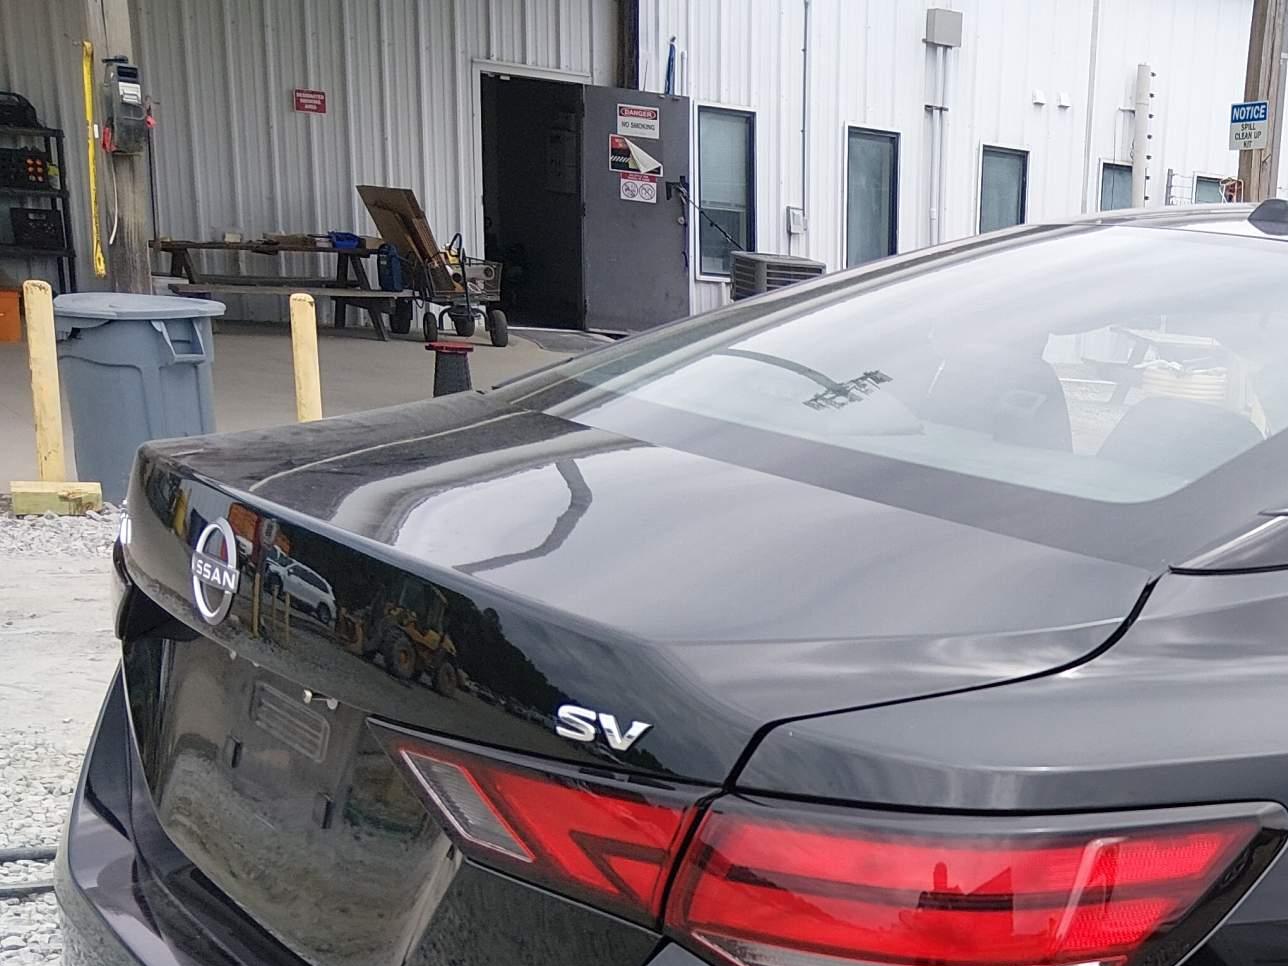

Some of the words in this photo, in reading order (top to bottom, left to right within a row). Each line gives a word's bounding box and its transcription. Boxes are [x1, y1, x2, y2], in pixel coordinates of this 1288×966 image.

[624, 109, 652, 118] DANGER
[1232, 104, 1266, 120] NOTICE
[631, 122, 656, 131] SMOKING
[1241, 123, 1256, 131] SPILL
[1234, 131, 1253, 140] CLEAN
[1253, 131, 1262, 139] UP
[1243, 140, 1253, 148] KIT
[195, 559, 237, 590] SSAN
[555, 704, 653, 752] SV
